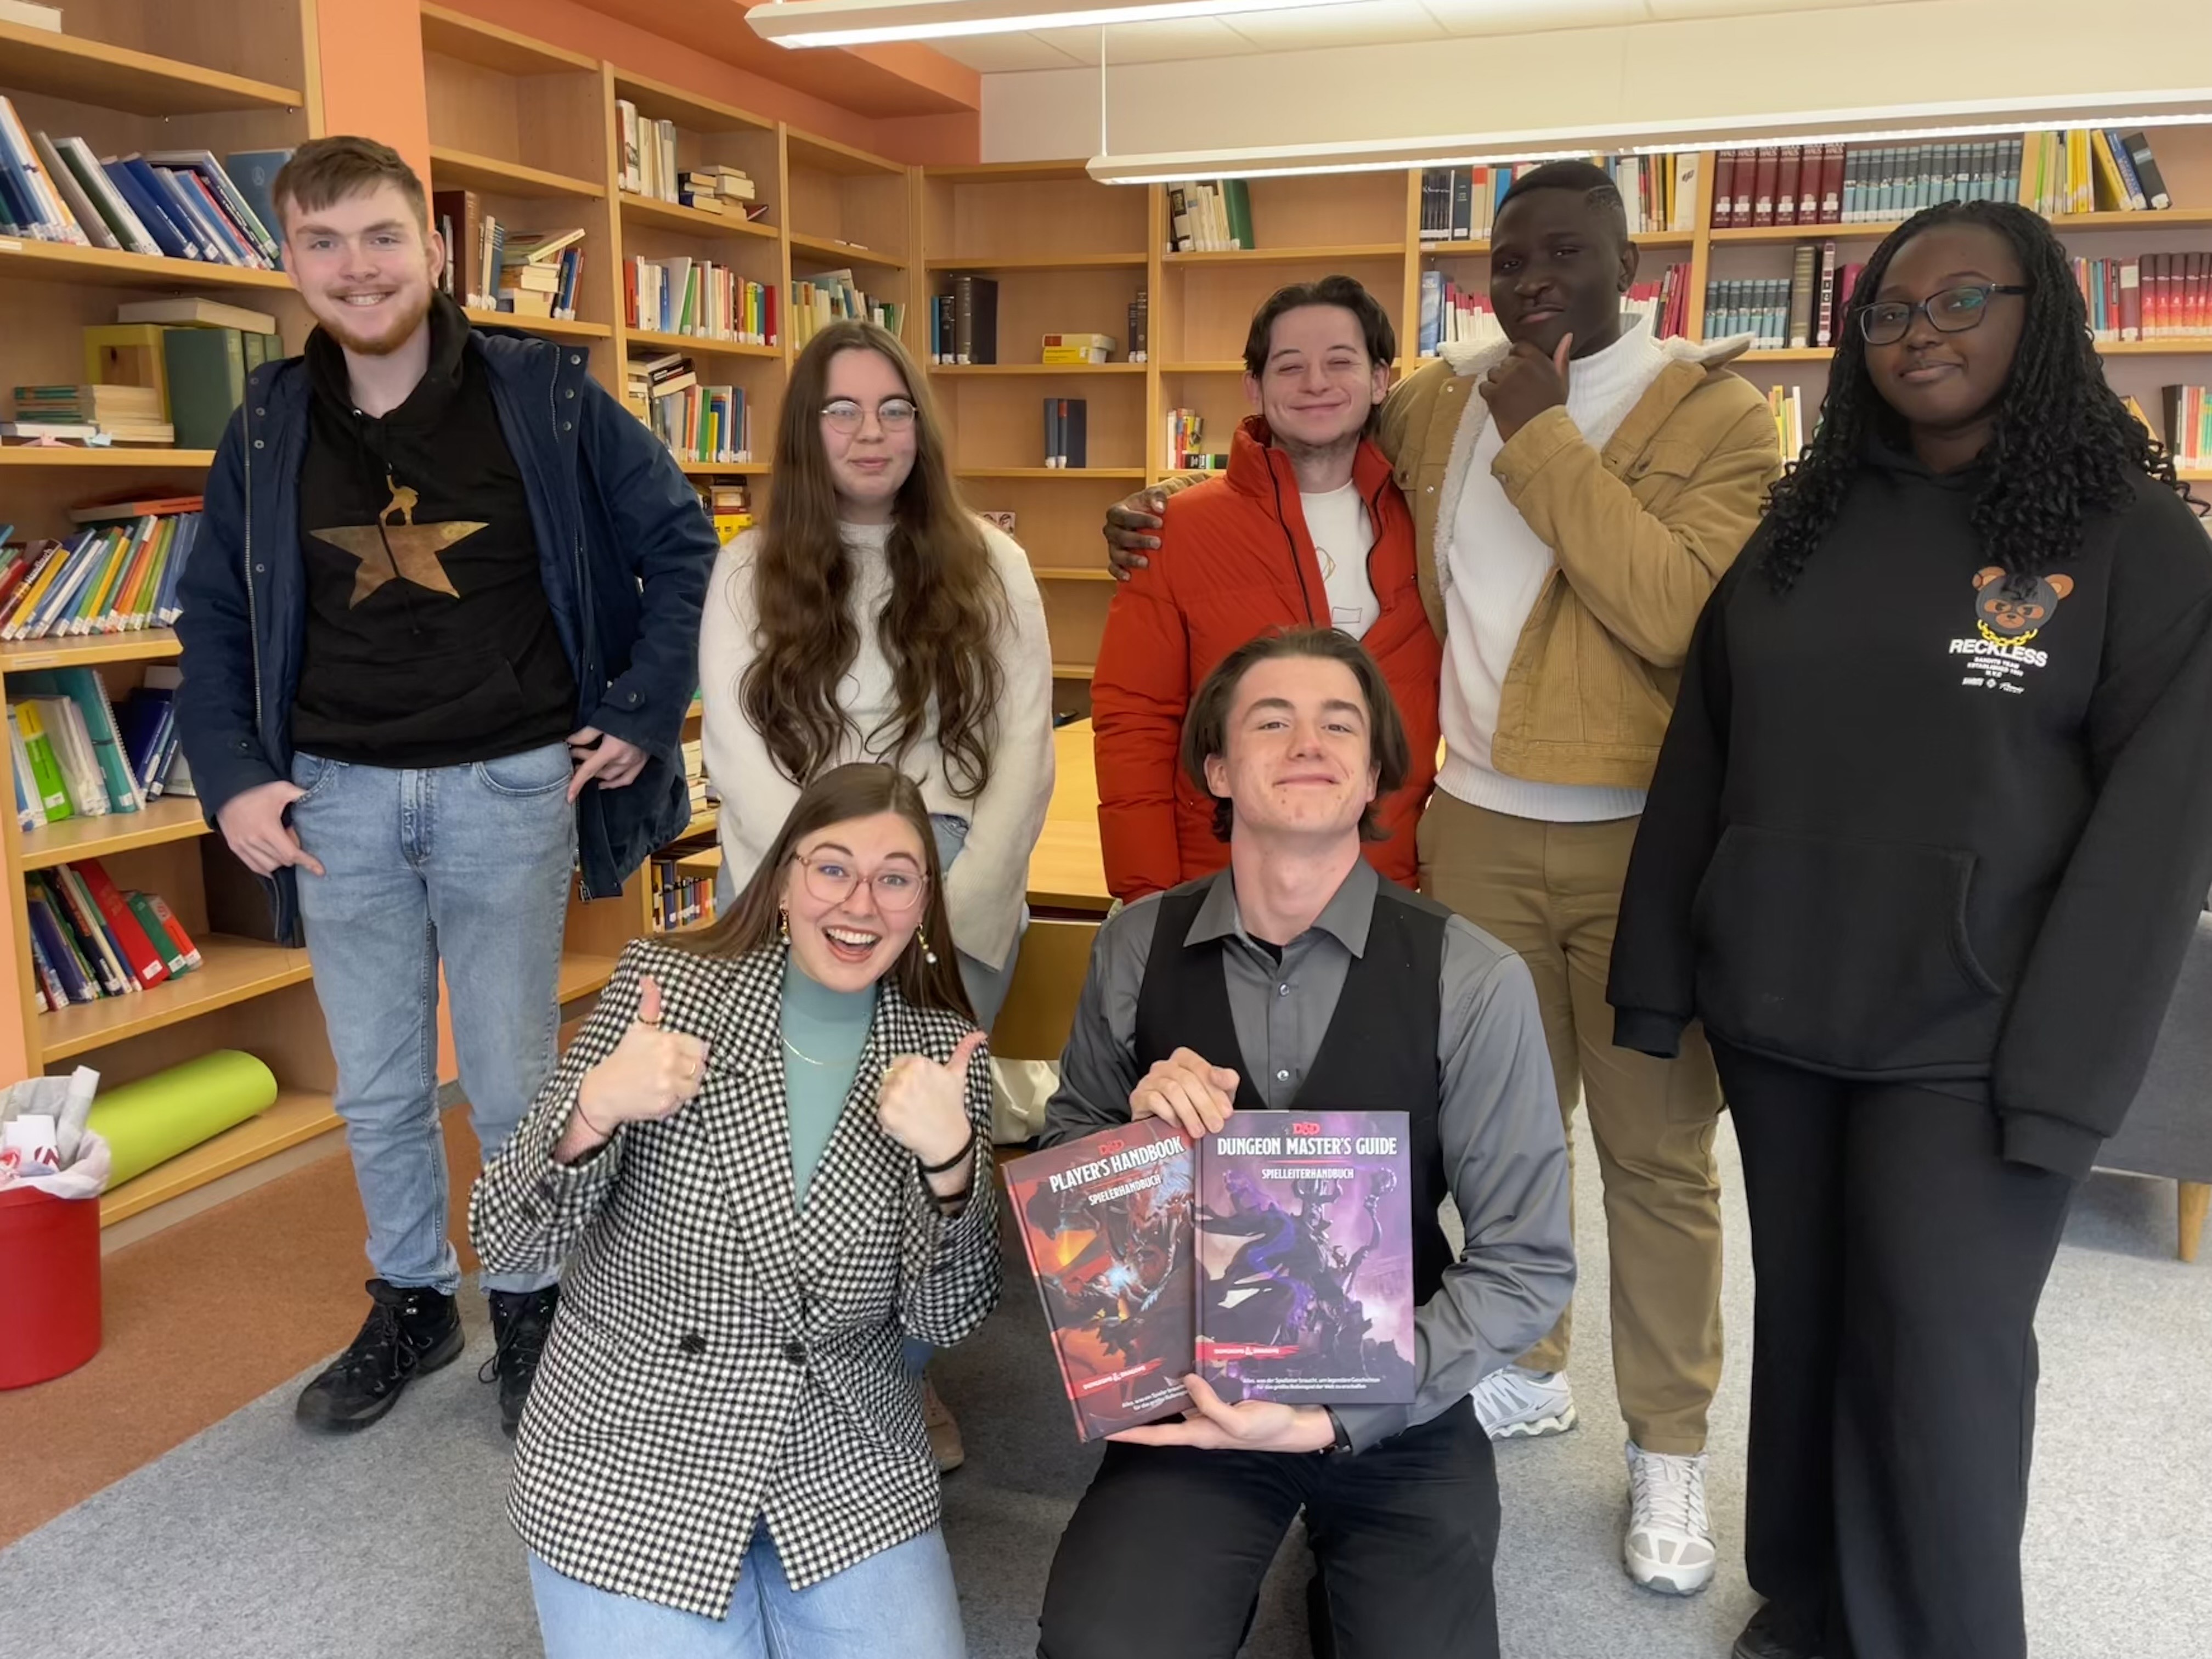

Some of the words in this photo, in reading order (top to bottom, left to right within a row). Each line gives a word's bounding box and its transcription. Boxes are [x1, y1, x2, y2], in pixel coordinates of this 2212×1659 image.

[1949, 639, 2048, 667] RECKLESS
[1217, 1138, 1282, 1155] DUNGEON
[1286, 1138, 1352, 1155] MASTER'S
[1356, 1138, 1397, 1155] GUIDE
[1049, 1159, 1110, 1193] PLAYER'S
[1110, 1136, 1185, 1173] HANDBOOK
[1262, 1169, 1354, 1179] SPIELLEITERHANDBUCH
[1088, 1173, 1161, 1206] SPIELERHANDBUCH
